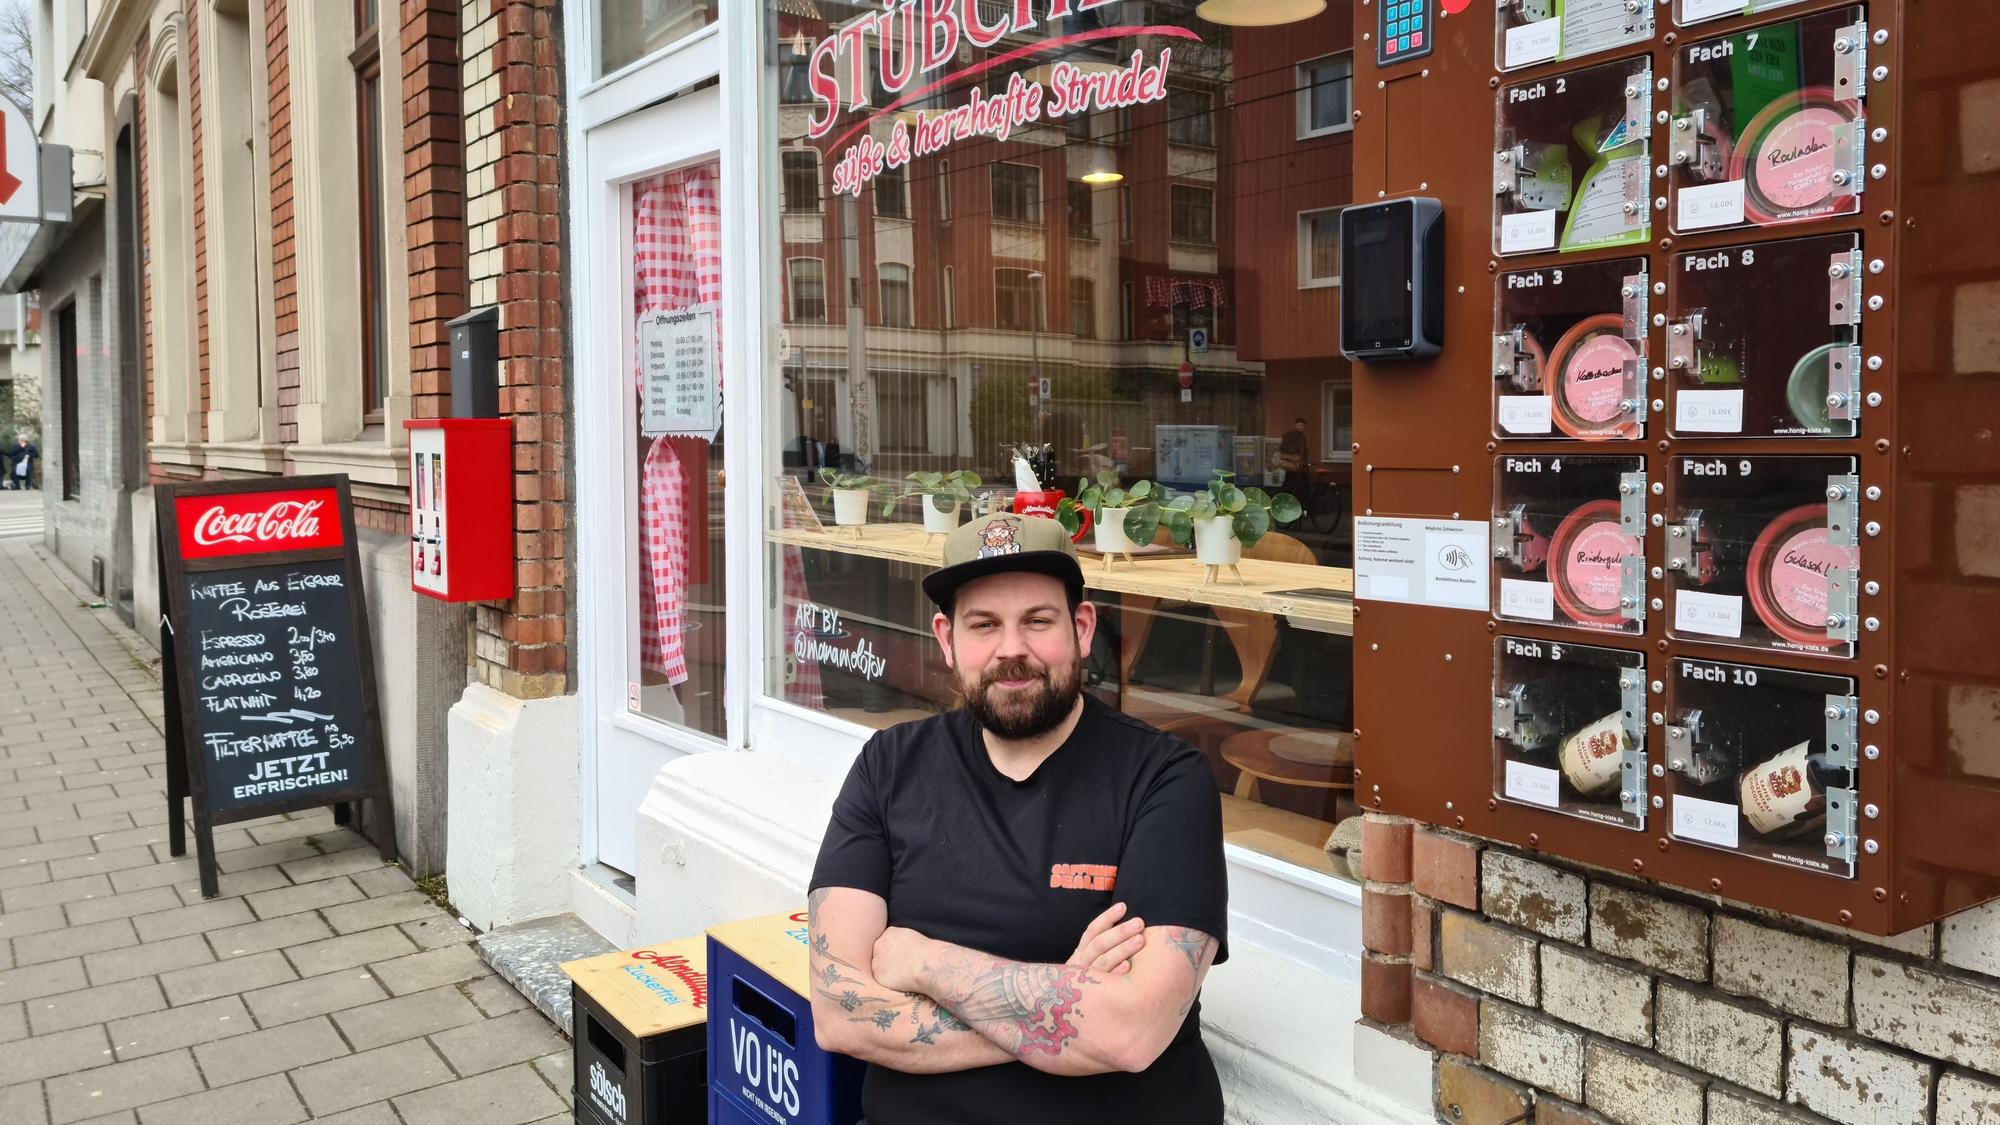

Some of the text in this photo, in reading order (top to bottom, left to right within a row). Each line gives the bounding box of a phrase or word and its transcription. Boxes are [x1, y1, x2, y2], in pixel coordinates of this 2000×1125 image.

[1689, 40, 1734, 64] Fach
[1746, 33, 1759, 51] 7
[809, 0, 1118, 138] STÜBC
[1509, 78, 1566, 104] Fach 2
[832, 47, 1171, 197] süße & herzhafte Strudel
[1776, 206, 1835, 219] www.honig-kiste.de
[1685, 249, 1754, 272] Fach 8
[1507, 270, 1563, 289] Fach 3
[1773, 426, 1831, 435] www.honig-kiste.de
[1506, 458, 1562, 473] Fach 4
[1683, 459, 1752, 476] Fach 9
[194, 500, 324, 545] Coca-Cola
[254, 579, 280, 594] AUS
[795, 602, 843, 634] ART BY:
[201, 629, 265, 651] ESPRESSO
[1506, 639, 1561, 660] Fach 5
[1771, 641, 1829, 653] www.honig-kiste.de
[201, 651, 274, 671] AMERICANO
[1682, 663, 1757, 687] Fach 10
[248, 752, 331, 781] JETZT
[233, 768, 348, 799] ERFRISCHEN!
[1772, 852, 1829, 870] www.honig-kiste.de
[624, 963, 682, 1006] Zuckerfrei
